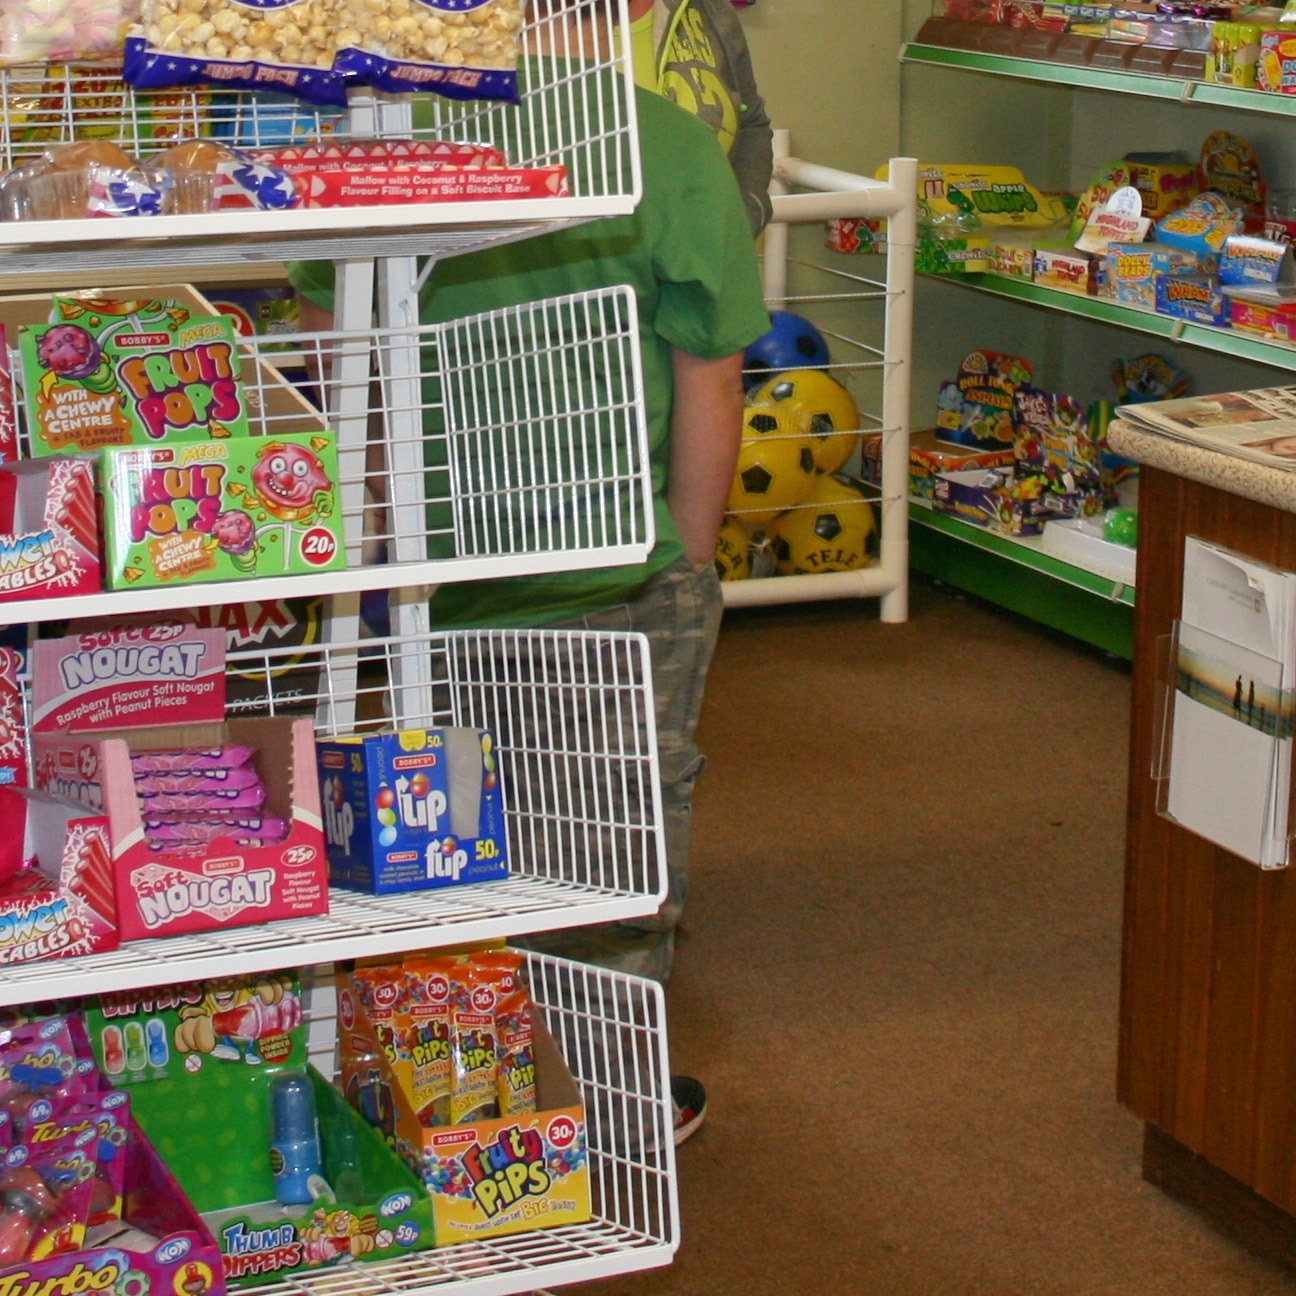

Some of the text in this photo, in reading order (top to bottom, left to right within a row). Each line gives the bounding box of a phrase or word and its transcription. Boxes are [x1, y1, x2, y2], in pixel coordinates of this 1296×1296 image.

[256, 65, 298, 87] PACK
[444, 68, 483, 89] PACK
[341, 186, 379, 196] Flavour
[381, 186, 413, 198] Filling
[415, 187, 430, 195] on
[440, 185, 463, 195] Soft
[466, 184, 502, 194] Biscuit
[505, 185, 531, 194] Base
[350, 175, 385, 185] Mallow
[388, 175, 409, 185] with
[413, 175, 455, 185] Coconut
[469, 173, 522, 186] Raspberry
[180, 323, 225, 347] MEGA
[121, 344, 232, 399] FRUIT
[44, 396, 116, 421] A CHEWY
[53, 389, 87, 405] WITH
[138, 380, 240, 439] POPS
[47, 413, 113, 434] CENTRE
[180, 444, 227, 466] MEGA
[131, 497, 220, 542] POPS
[158, 536, 183, 550] WITH
[163, 536, 203, 561] CHEWY
[305, 536, 334, 554] 20p
[158, 550, 202, 572] CENTRE
[61, 642, 206, 691] NOUGAT
[56, 681, 216, 726] Raspberry Flavour Soft Nougat
[89, 695, 187, 723] with Peanut Pieces
[136, 871, 188, 899] Soft
[139, 869, 272, 928] NOUGAT
[552, 1125, 573, 1140] 30p
[224, 1223, 295, 1255] THUMB
[396, 1227, 418, 1241] 59p
[221, 1242, 302, 1278] DIPPERS
